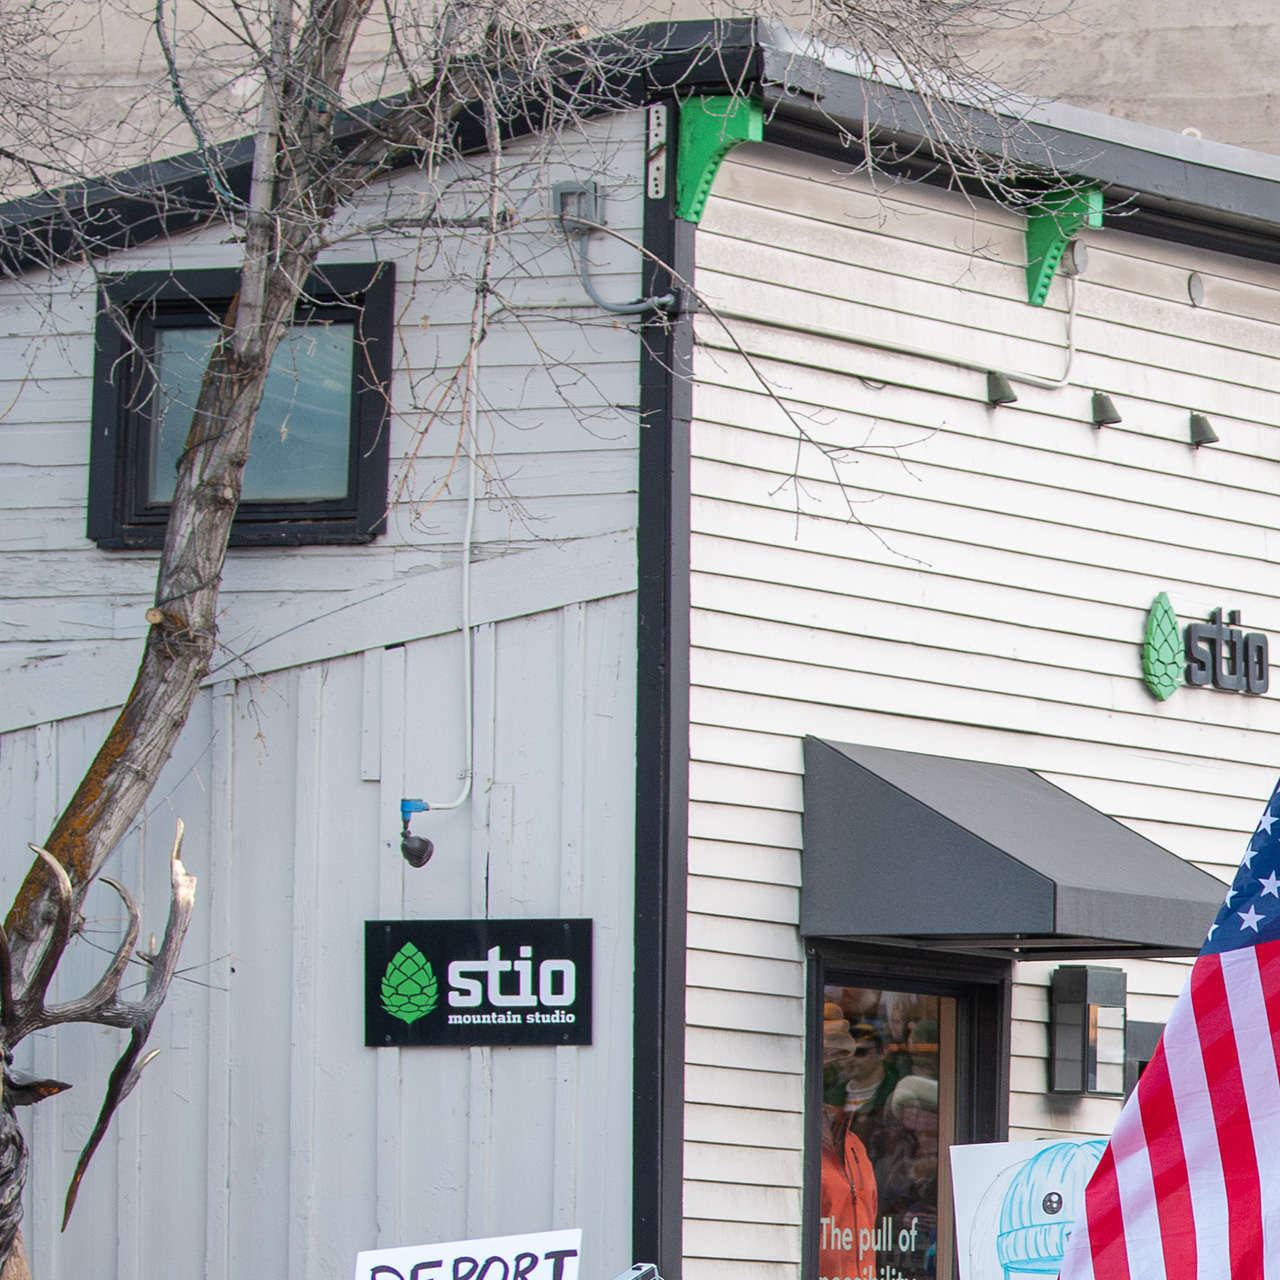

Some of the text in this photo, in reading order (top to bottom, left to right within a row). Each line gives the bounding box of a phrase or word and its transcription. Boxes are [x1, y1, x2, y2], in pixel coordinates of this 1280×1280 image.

[1184, 606, 1269, 695] stio
[447, 945, 576, 1007] stio
[448, 1011, 576, 1024] mountain studio
[820, 1216, 918, 1260] The pull of
